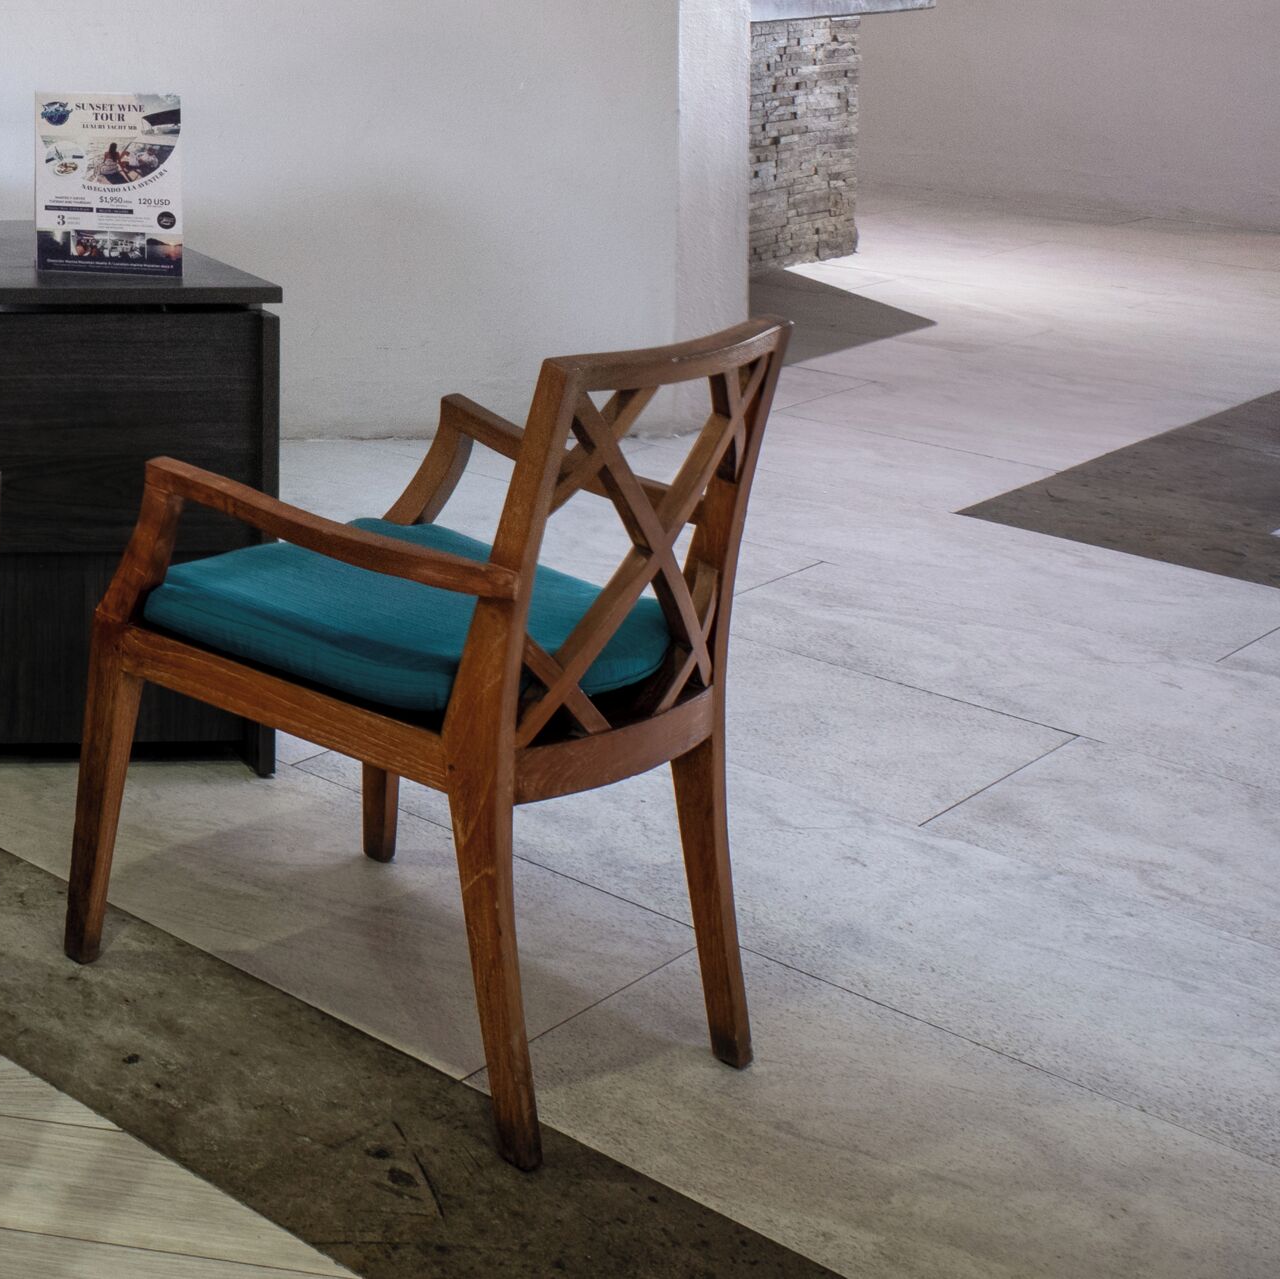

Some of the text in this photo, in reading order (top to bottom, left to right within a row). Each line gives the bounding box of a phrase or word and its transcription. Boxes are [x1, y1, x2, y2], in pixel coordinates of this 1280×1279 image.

[75, 102, 145, 113] SUNSET WINE
[93, 112, 125, 122] TOUR
[137, 169, 168, 190] AVENTURA
[99, 196, 123, 204] $1,950
[153, 198, 170, 206] USD
[57, 215, 66, 226] 3
